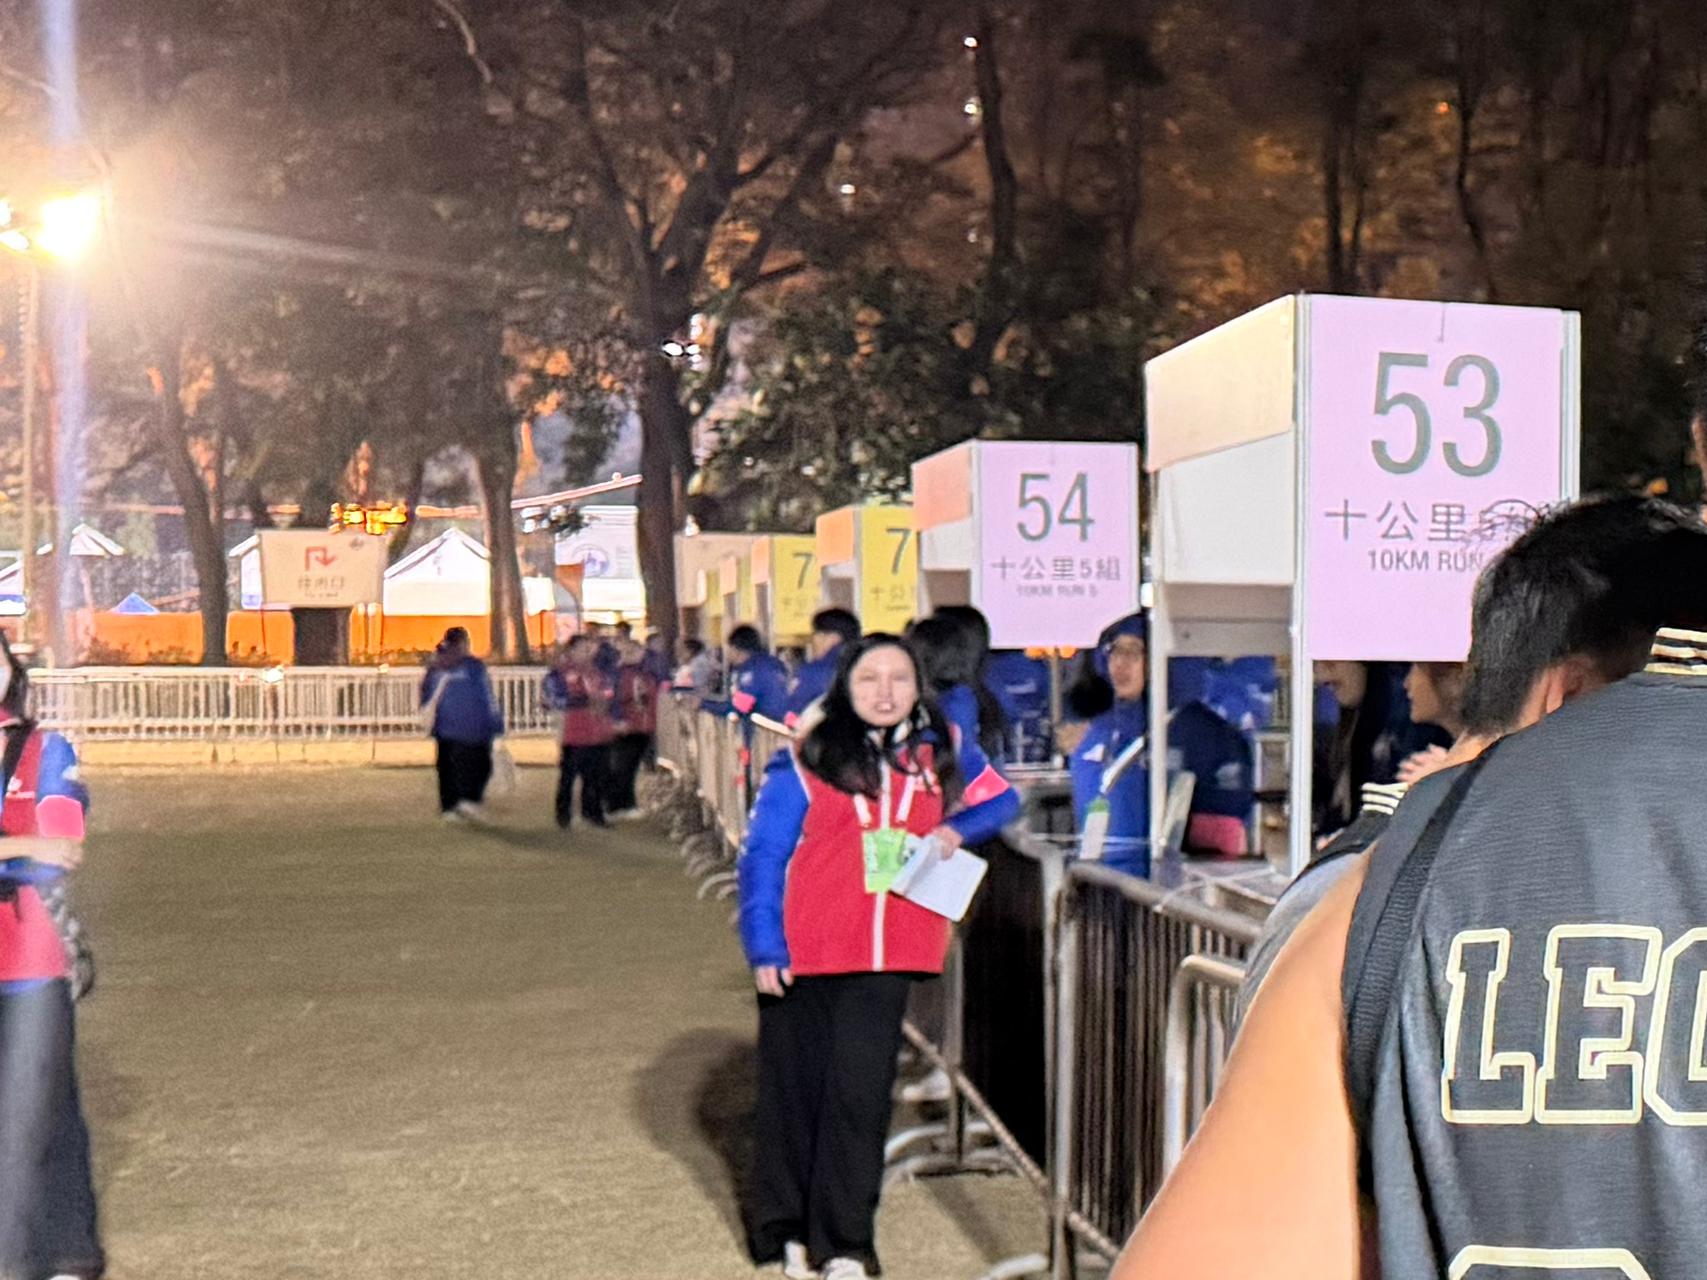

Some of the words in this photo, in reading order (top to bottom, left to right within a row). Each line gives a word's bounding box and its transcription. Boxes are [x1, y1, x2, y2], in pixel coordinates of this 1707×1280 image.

[1370, 351, 1503, 477] 53
[1016, 472, 1095, 542] 54
[792, 552, 814, 589] 7
[886, 528, 912, 575] 7
[990, 555, 1121, 581] 十公里5組
[1368, 549, 1430, 571] 10KM
[1438, 550, 1484, 572] RUN
